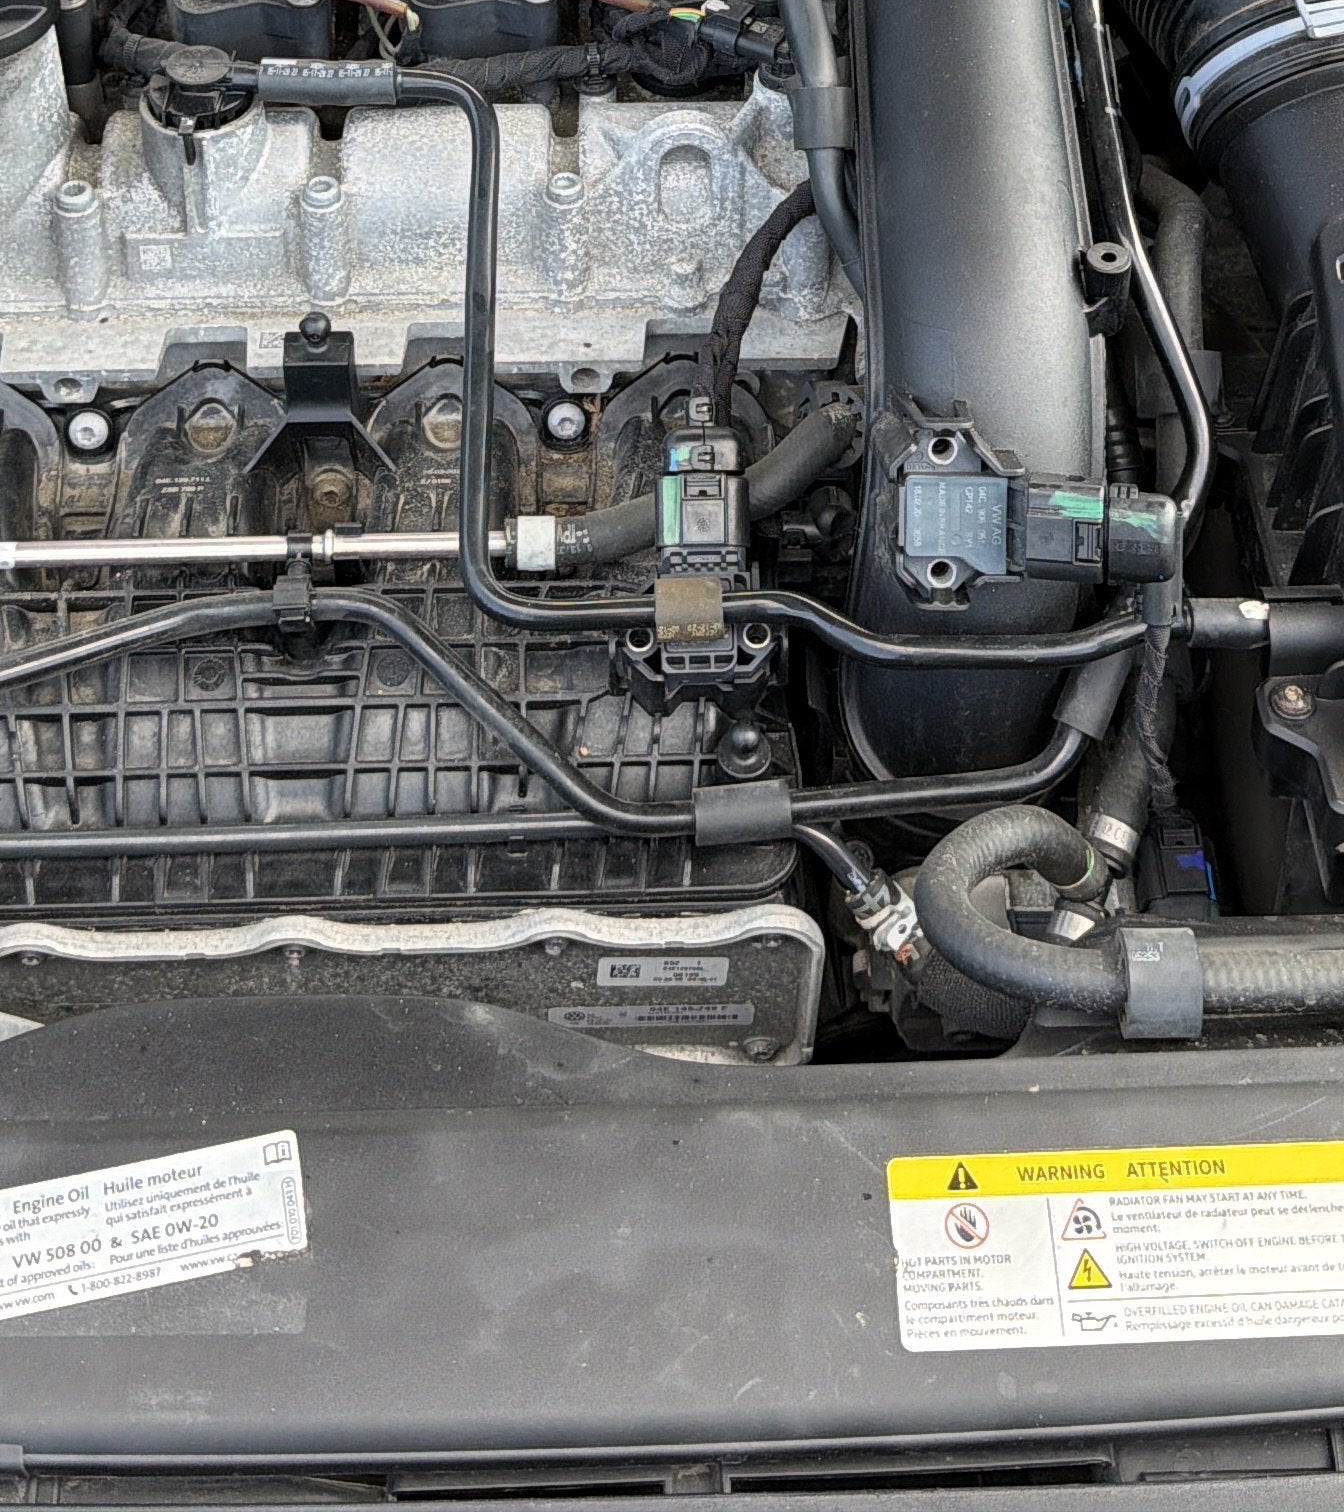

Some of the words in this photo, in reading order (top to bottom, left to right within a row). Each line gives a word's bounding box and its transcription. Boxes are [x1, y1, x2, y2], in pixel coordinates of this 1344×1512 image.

[992, 527, 1001, 545] AG
[1016, 1163, 1106, 1182] WARNING
[1127, 1159, 1226, 1179] ATTENTION
[103, 1175, 143, 1196] Huile
[147, 1165, 203, 1186] moteur
[13, 1194, 64, 1214] Engine
[68, 1186, 89, 1202] Oil
[104, 1196, 144, 1213] Utilisez
[146, 1181, 211, 1205] uniquement
[213, 1178, 227, 1190] de
[228, 1171, 261, 1188] l'huile
[1109, 1196, 1160, 1207] RADIATOR
[1163, 1194, 1183, 1204] FAN
[1186, 1193, 1207, 1203] MAY
[1210, 1192, 1240, 1203] START
[1243, 1192, 1253, 1201] AT
[1257, 1191, 1277, 1200] ANY
[1280, 1190, 1307, 1200] TIME.
[105, 1212, 124, 1227] qui
[125, 1202, 168, 1222] satisfait
[170, 1186, 244, 1213] expressément
[1111, 1212, 1123, 1221] Le
[1126, 1210, 1182, 1221] ventilateur
[1185, 1209, 1199, 1219] de
[1201, 1208, 1248, 1218] radiateur
[1251, 1205, 1275, 1217] peut
[1278, 1205, 1289, 1215] se
[3, 1220, 16, 1232] oil
[18, 1216, 40, 1229] that
[42, 1206, 91, 1224] expressly
[6, 1231, 31, 1244] with
[1113, 1224, 1160, 1234] moment.
[12, 1250, 41, 1268] VW
[46, 1244, 76, 1262] 508
[80, 1238, 101, 1255] 00
[110, 1236, 123, 1249] &
[131, 1225, 161, 1245] SAE
[165, 1213, 219, 1237] 0W-20
[110, 1251, 133, 1265] Pour
[136, 1248, 155, 1260] une
[157, 1242, 179, 1255] liste
[181, 1232, 221, 1251] d'huiles
[1116, 1242, 1141, 1253] HIGH
[1194, 1239, 1233, 1249] SWITCH
[1235, 1238, 1254, 1248] OFF
[1258, 1237, 1296, 1247] ENGINE
[1299, 1235, 1337, 1245] BEFORE
[925, 1256, 957, 1266] PARTS
[960, 1256, 971, 1265] IN
[973, 1254, 1012, 1265] MOTOR
[1117, 1254, 1163, 1265] IGNITION
[7, 1274, 18, 1287] of
[21, 1263, 71, 1285] approved
[73, 1260, 95, 1272] oils:
[1119, 1270, 1151, 1279] Haute
[1237, 1265, 1246, 1275] le
[1322, 1262, 1335, 1272] de
[81, 1266, 161, 1294] 1-800-822-8987
[904, 1283, 946, 1293] MOVING
[905, 1300, 968, 1312] Composants
